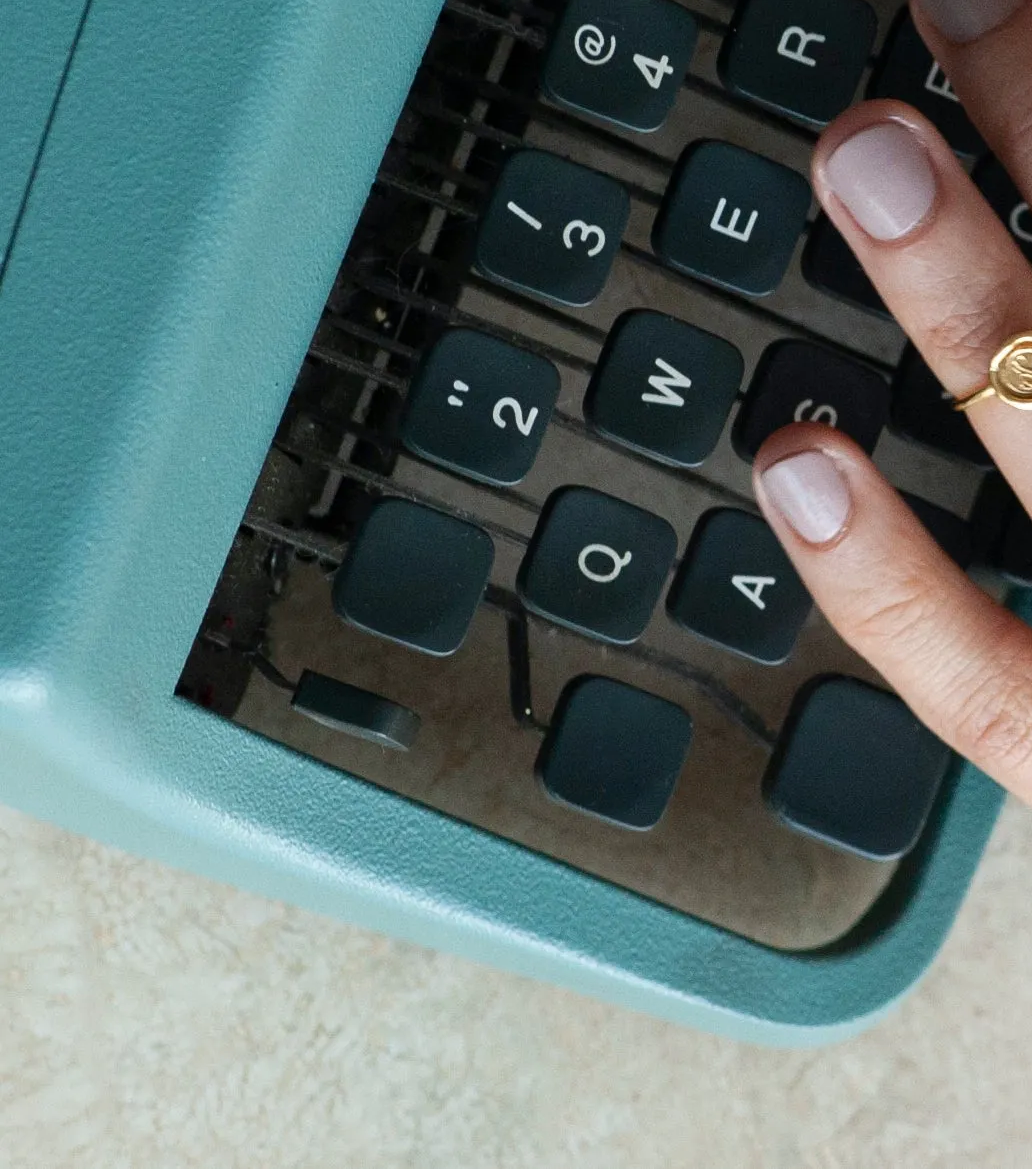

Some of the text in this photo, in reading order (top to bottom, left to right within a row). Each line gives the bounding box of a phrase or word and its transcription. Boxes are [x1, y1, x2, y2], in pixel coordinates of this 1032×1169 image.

[574, 24, 617, 66] @
[776, 26, 826, 67] R
[632, 53, 674, 90] 4
[562, 219, 606, 257] 3
[709, 197, 759, 242] E
[641, 357, 692, 407] W
[492, 396, 539, 437] 2
[577, 543, 633, 583] Q
[731, 575, 776, 610] A
